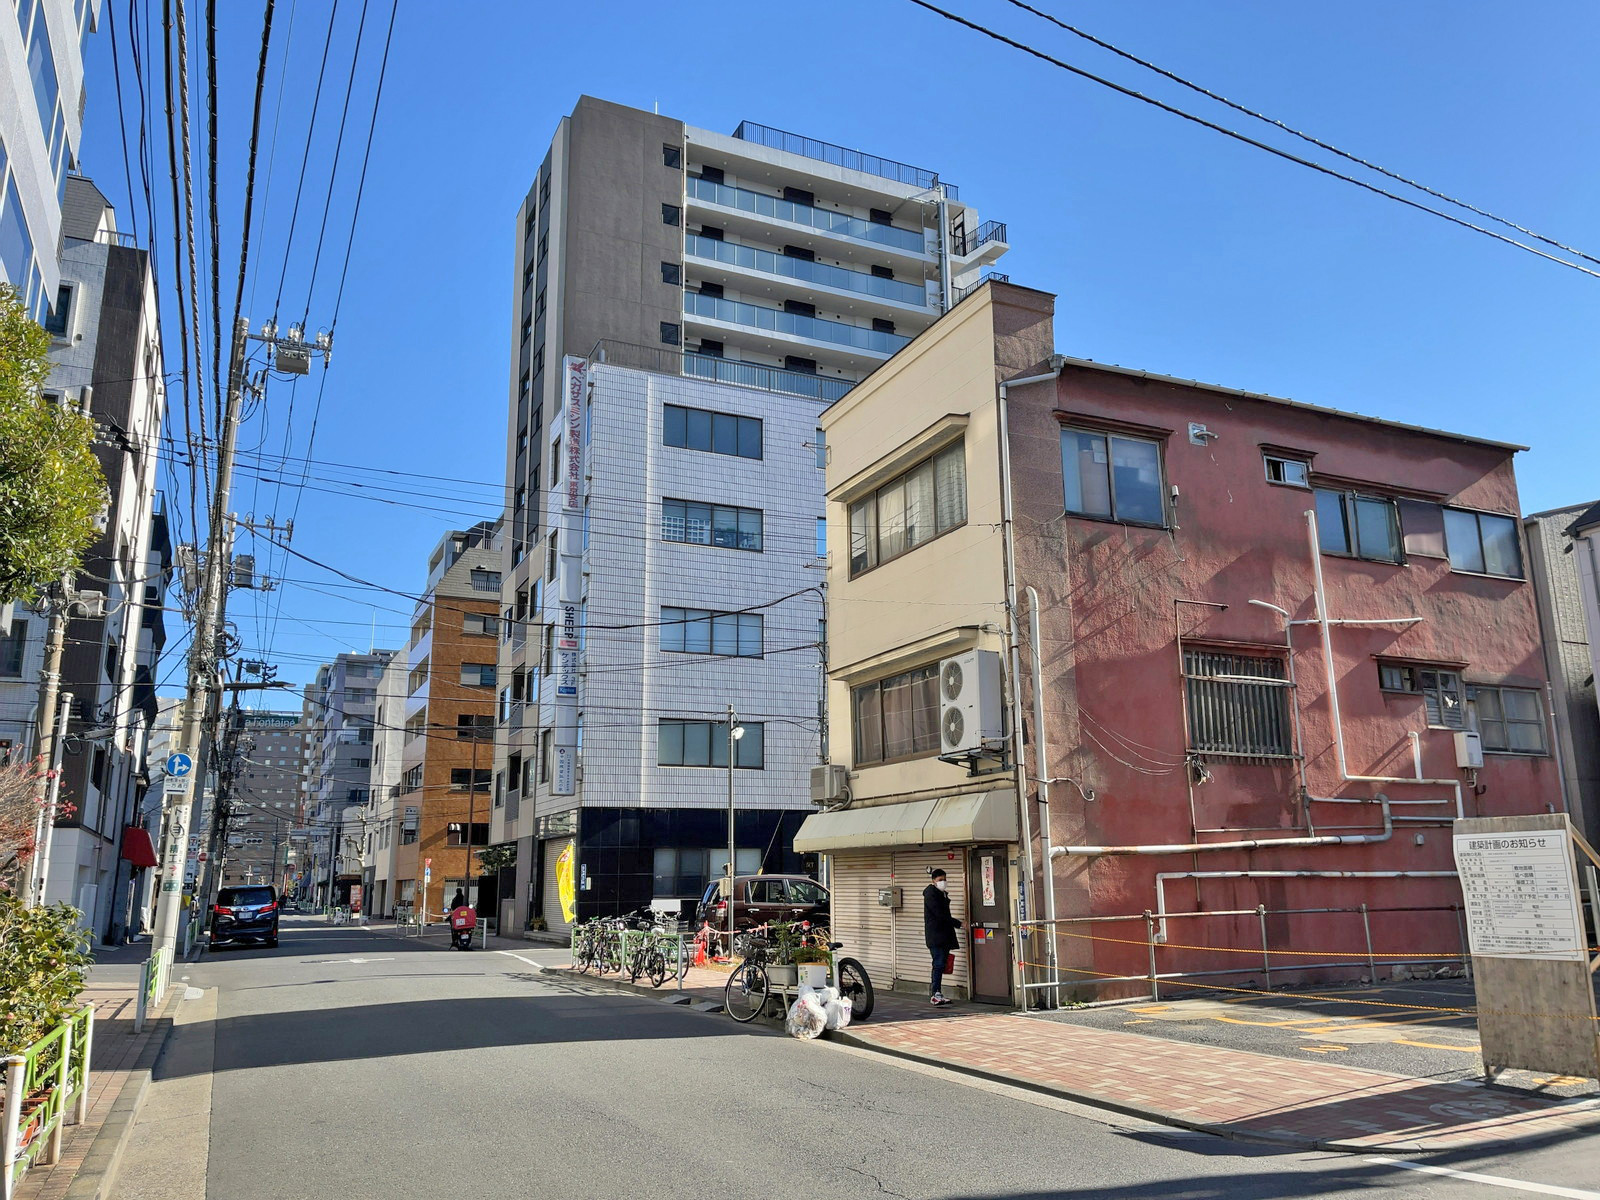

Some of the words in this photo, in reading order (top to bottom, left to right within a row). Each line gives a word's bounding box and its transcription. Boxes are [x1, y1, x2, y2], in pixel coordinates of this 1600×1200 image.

[564, 606, 575, 639] SHEEP
[1469, 839, 1546, 850] 建築計画のお知らせ
